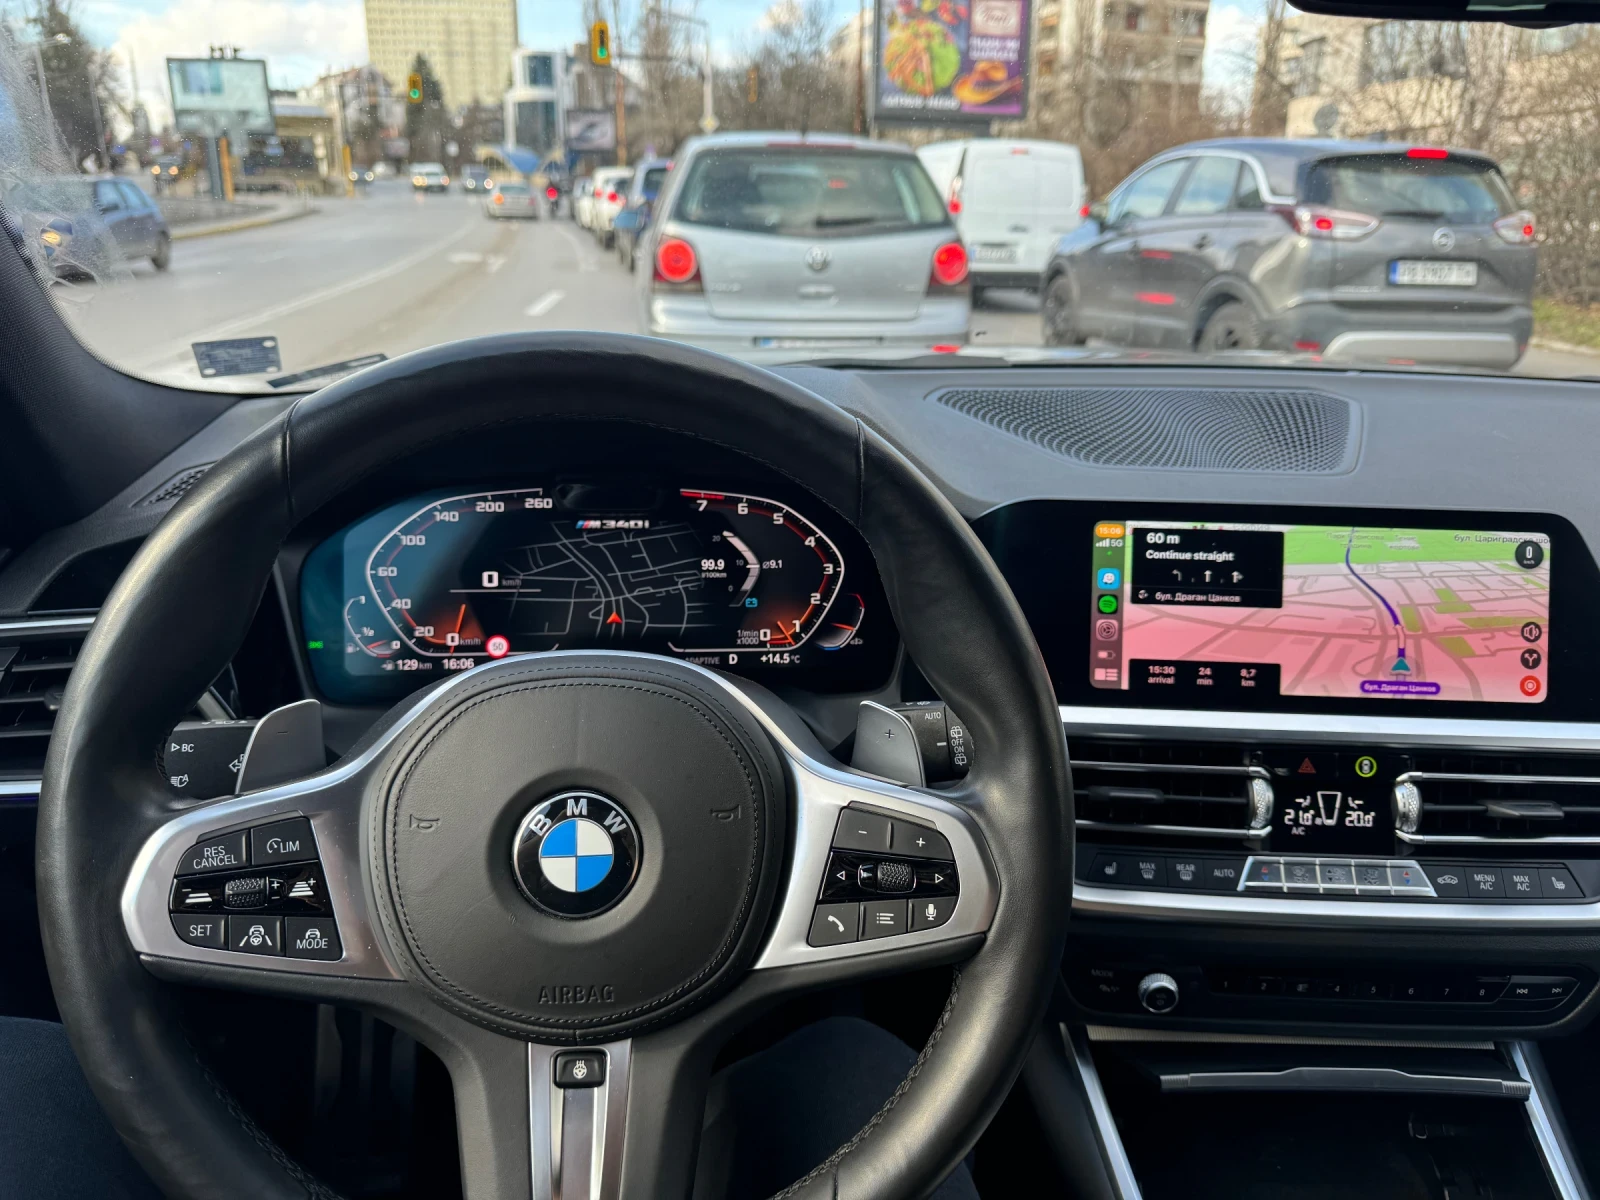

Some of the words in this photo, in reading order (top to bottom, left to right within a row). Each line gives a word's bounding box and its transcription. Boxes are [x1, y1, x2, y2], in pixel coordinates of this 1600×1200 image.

[475, 501, 505, 513] 200
[524, 498, 552, 509] 260
[696, 500, 708, 511] 7
[737, 503, 749, 514] 6
[433, 511, 459, 522] 140
[772, 513, 784, 524] 5
[1098, 526, 1122, 535] 15:06
[400, 535, 426, 546] 100
[804, 537, 816, 547] 4
[1110, 539, 1123, 547] 5G
[1146, 532, 1165, 544] 60
[1166, 535, 1180, 544] m
[1145, 549, 1192, 560] Continue
[1193, 550, 1235, 563] straight
[1525, 546, 1533, 559] 0
[701, 559, 725, 571] 99.9
[823, 564, 834, 575] 3
[377, 567, 397, 577] 60
[482, 571, 499, 588] 0
[810, 593, 821, 605] 2
[1155, 592, 1173, 602] бул.
[1174, 592, 1207, 603] Драган
[1208, 594, 1241, 603] Цанков
[391, 598, 411, 609] 40
[413, 626, 434, 637] 20
[791, 620, 800, 632] 1
[445, 633, 459, 646] 0
[460, 636, 481, 646] km/h
[760, 629, 771, 641] 0
[492, 642, 505, 651] 50
[442, 658, 475, 670] 16:06
[728, 653, 738, 665] D
[396, 659, 418, 671] 129
[419, 661, 433, 670] km
[1148, 665, 1176, 674] 15:30
[1198, 667, 1212, 675] 24
[1147, 675, 1175, 684] arrival
[1196, 677, 1213, 685] min
[1241, 679, 1255, 687] km
[924, 711, 942, 720] AUTO
[181, 743, 195, 752] BC
[529, 798, 628, 836] BMW
[203, 845, 226, 858] RES
[280, 841, 300, 853] LIM
[193, 854, 238, 869] CANCEL
[1139, 861, 1156, 870] MAX
[1175, 863, 1195, 872] REAR
[1213, 868, 1235, 877] AUTO
[1474, 874, 1495, 883] MENU
[1513, 875, 1530, 884] MAX
[1480, 882, 1494, 891] A/C
[1517, 883, 1531, 891] A/C
[189, 924, 212, 937] SET
[296, 938, 328, 949] MODE
[539, 986, 615, 1005] AIRBAG
